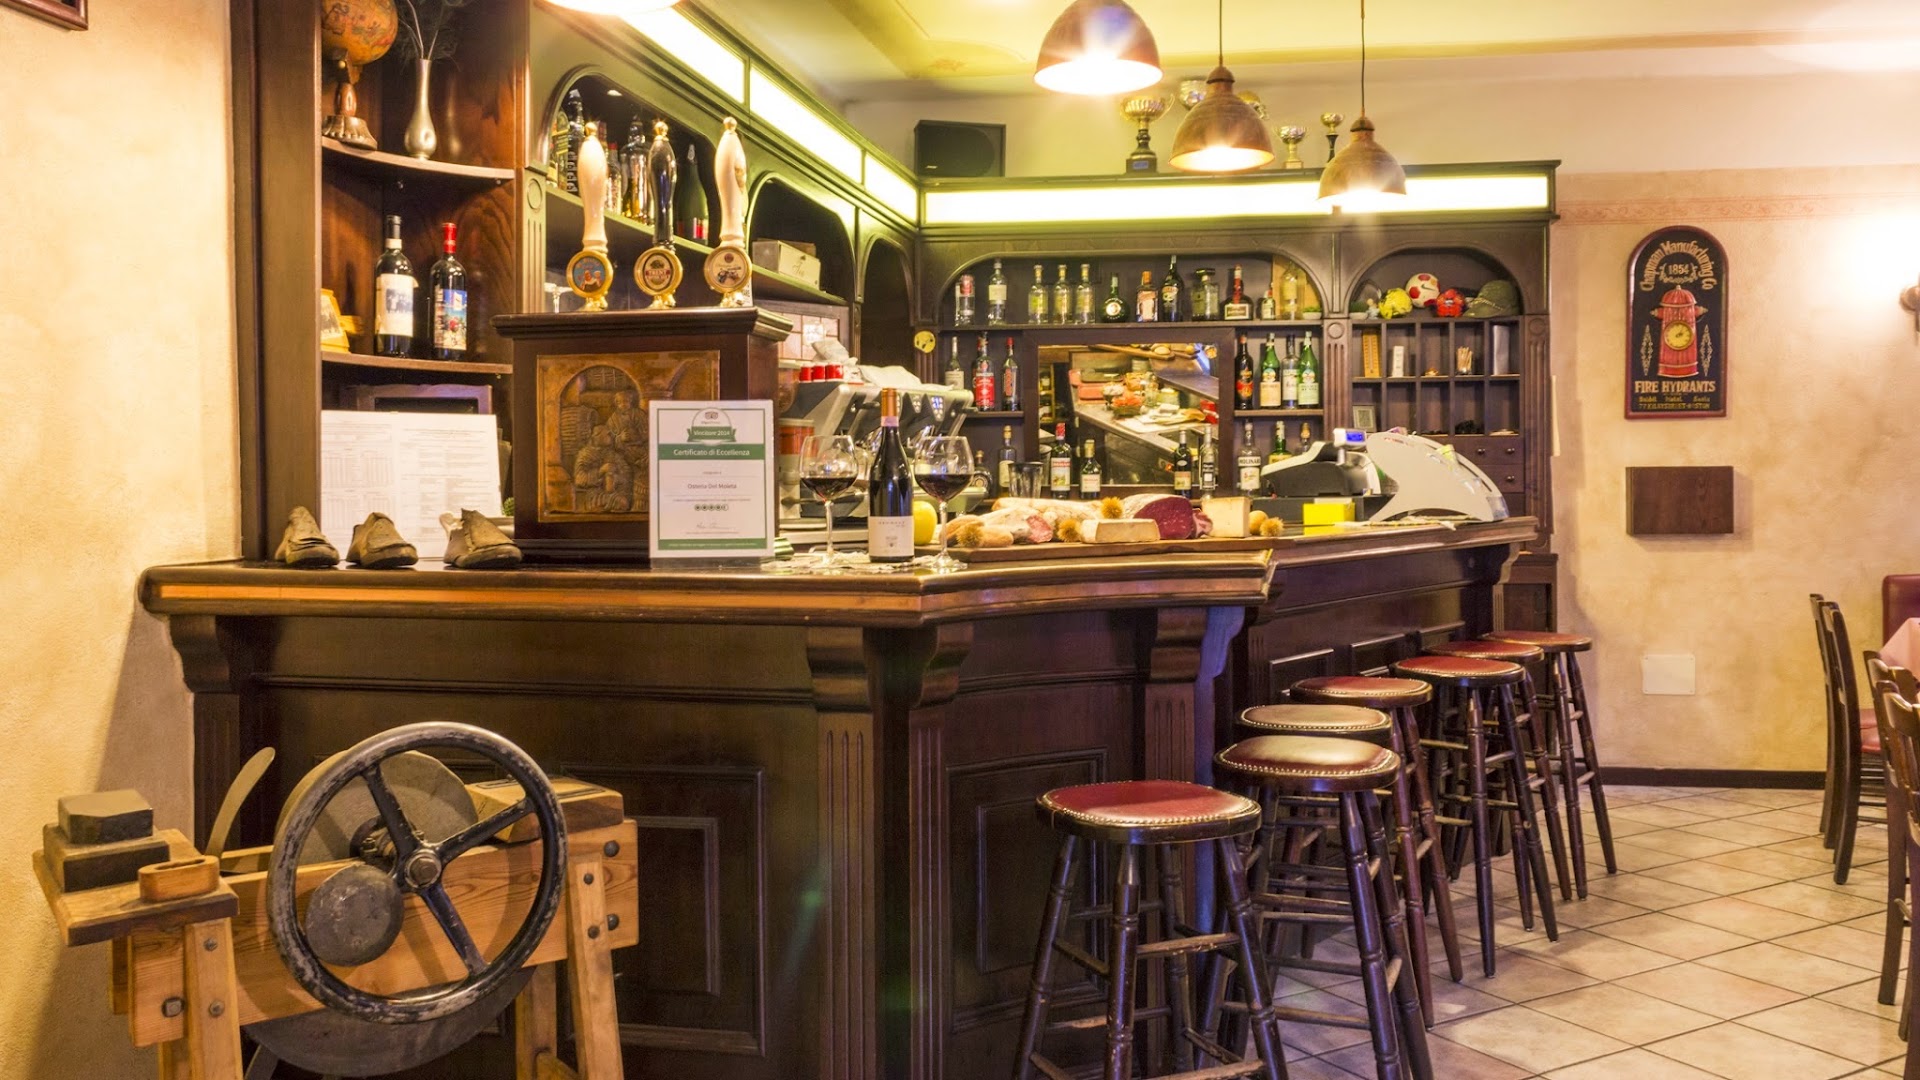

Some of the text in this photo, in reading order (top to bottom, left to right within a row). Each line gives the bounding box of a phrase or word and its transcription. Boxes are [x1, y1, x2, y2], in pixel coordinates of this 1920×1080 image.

[1639, 248, 1666, 292] Chapman
[1660, 240, 1714, 278] Manufacturing
[1668, 263, 1690, 275] 1854
[1634, 380, 1716, 393] FIRE HYDRANTS
[673, 448, 750, 456] Certificato di Eccellenza
